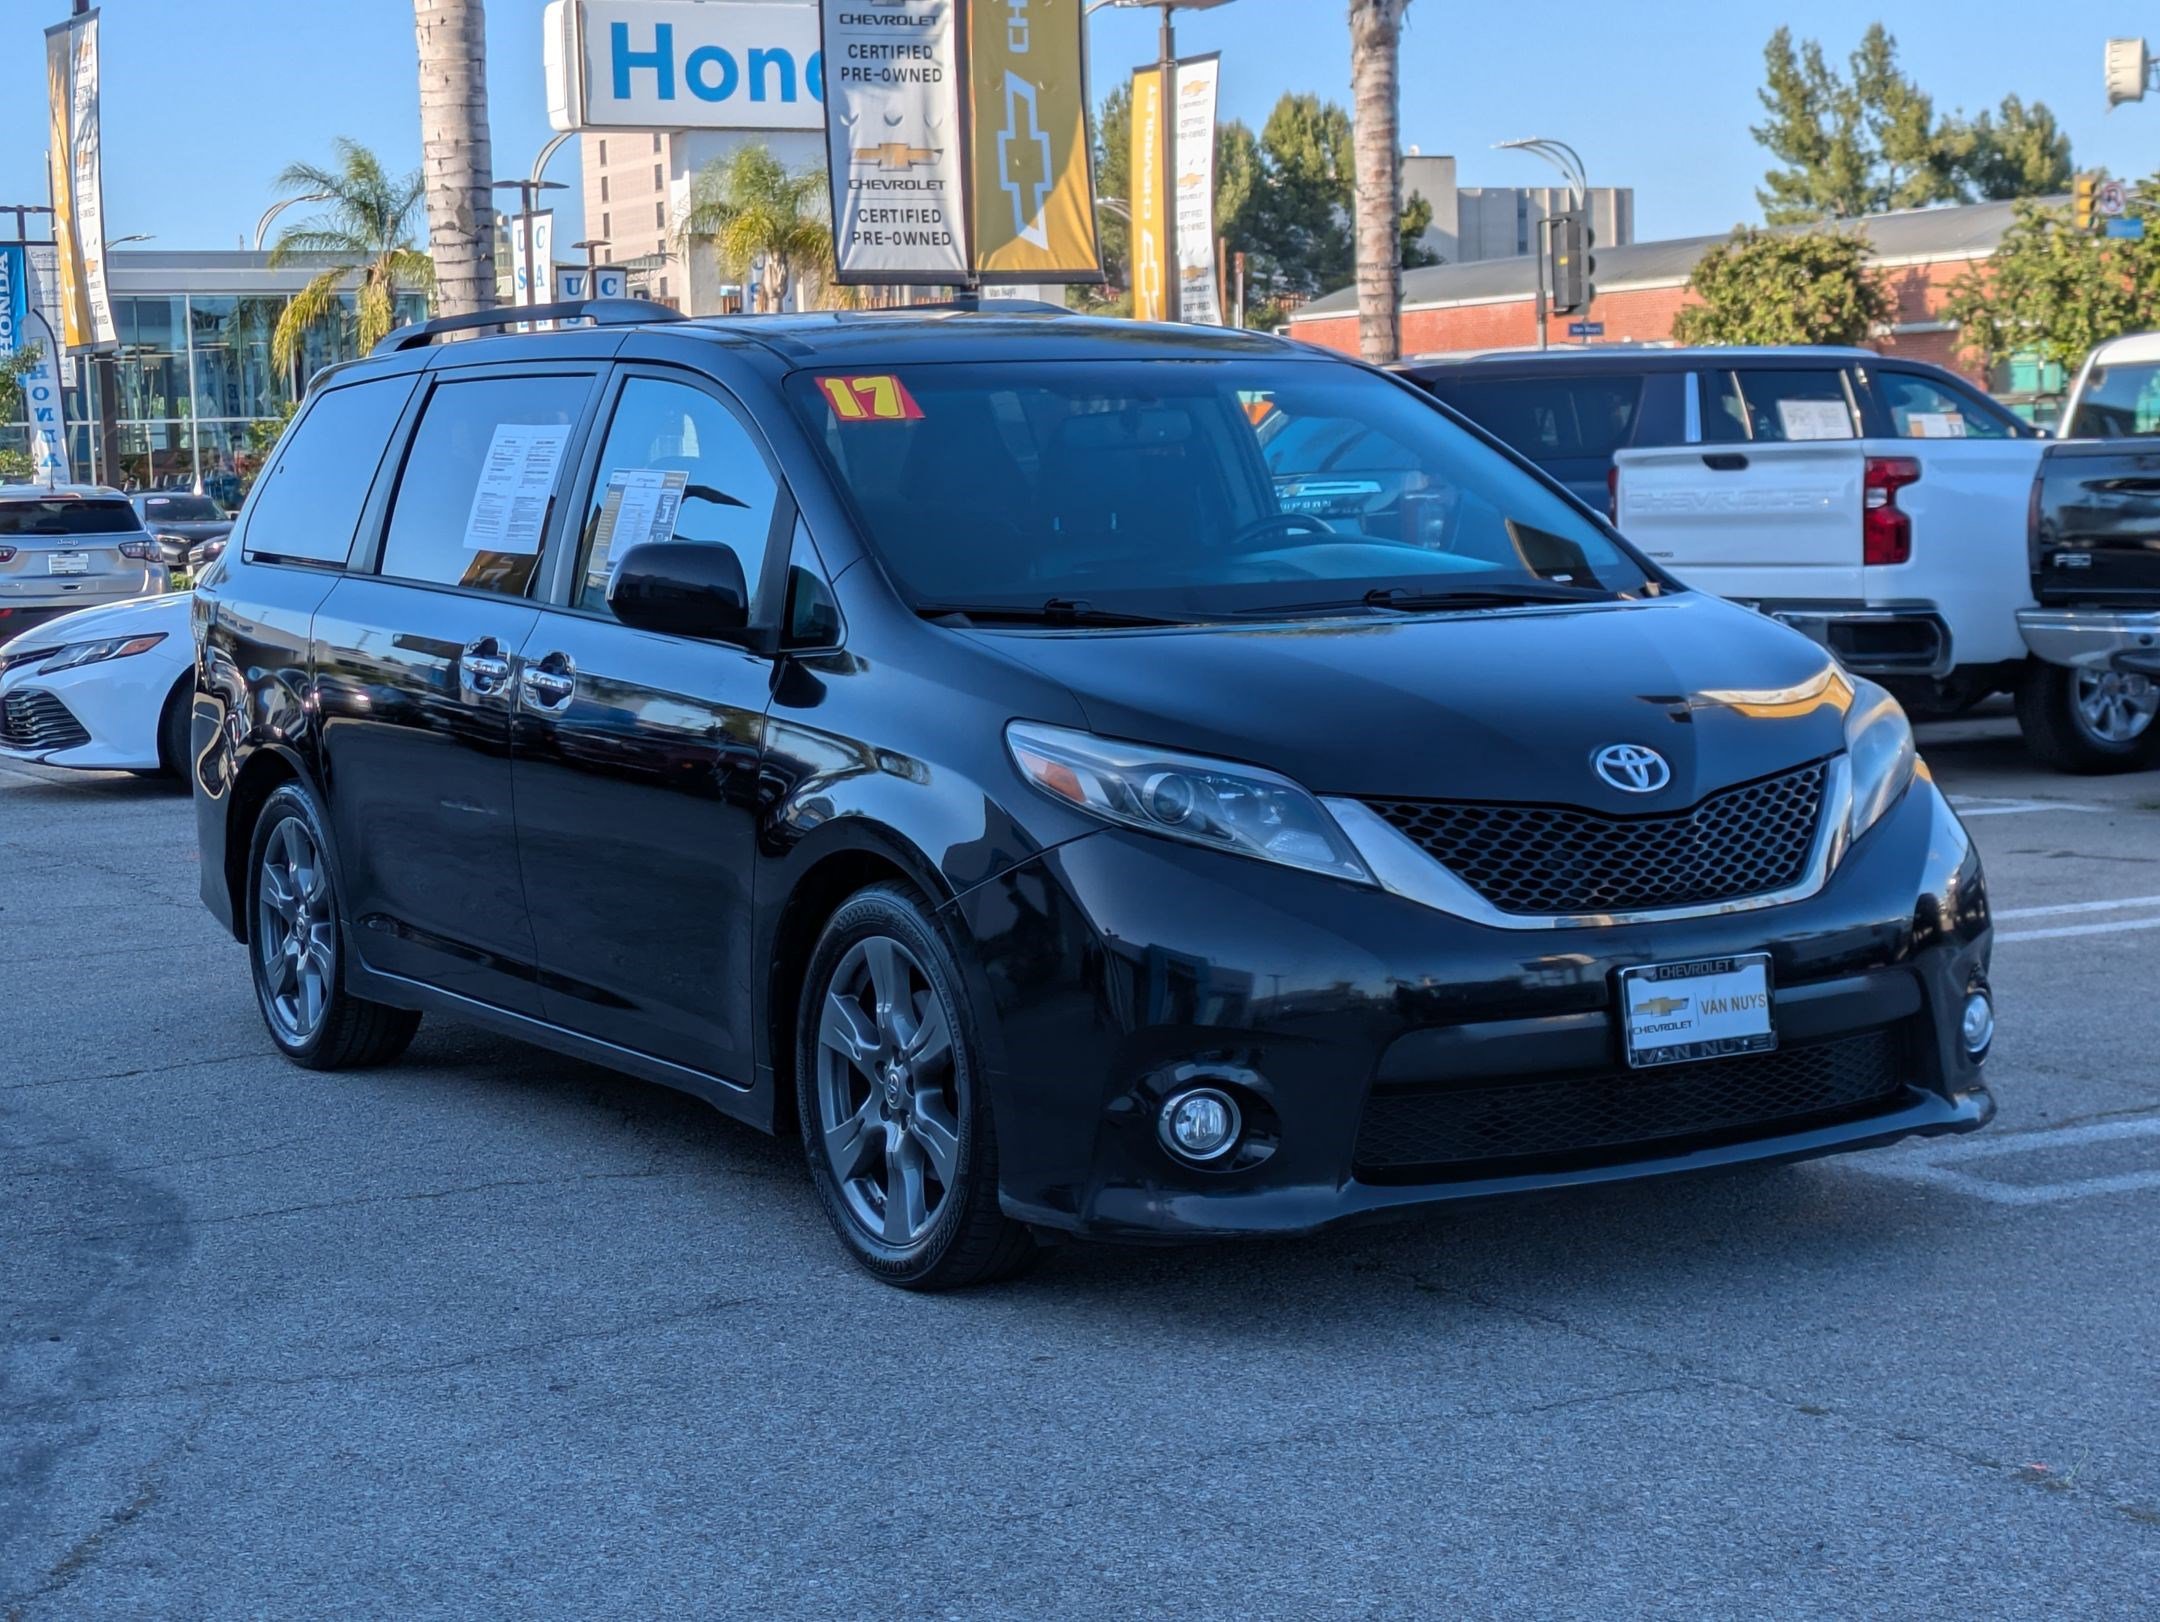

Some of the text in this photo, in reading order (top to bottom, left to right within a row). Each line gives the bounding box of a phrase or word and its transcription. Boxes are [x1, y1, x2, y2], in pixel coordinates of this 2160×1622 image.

[839, 13, 938, 26] CHEVROLET
[848, 44, 933, 60] CERTIFIED
[841, 67, 942, 83] PRE-OWNED
[1142, 84, 1158, 220] CHEVROLET
[849, 179, 945, 191] CHEVROLET
[858, 208, 942, 224] CERTIFIED
[852, 231, 952, 246] PRE-OWNED
[825, 375, 906, 419] 17
[1659, 959, 1732, 978] CHEVROLET
[1701, 994, 1766, 1015] VAN NUYS
[1632, 1020, 1693, 1035] CHEVROLET
